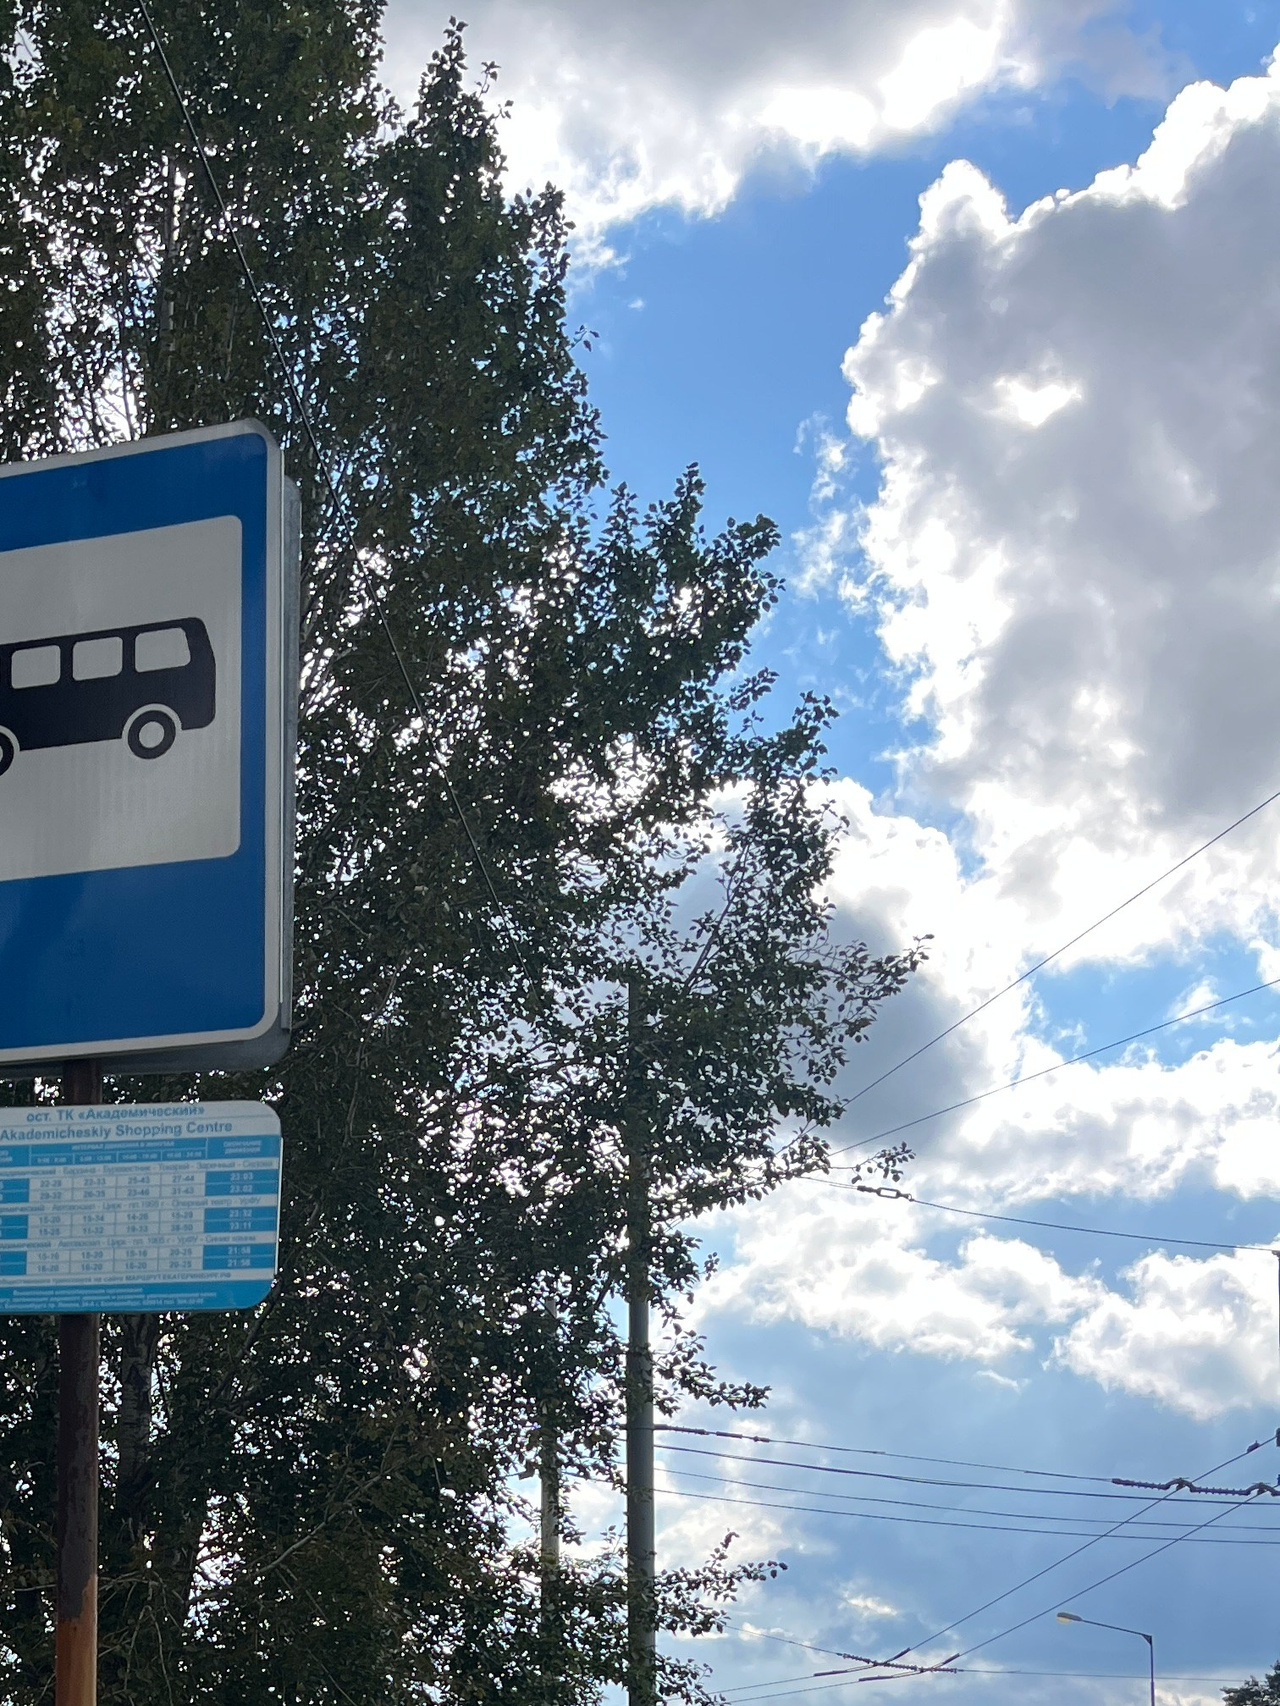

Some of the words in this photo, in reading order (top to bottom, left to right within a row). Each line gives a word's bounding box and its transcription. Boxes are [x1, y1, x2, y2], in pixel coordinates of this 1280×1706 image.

[26, 1112, 51, 1122] ост.
[56, 1109, 74, 1120] ТК
[78, 1105, 205, 1120] «Академический»
[0, 1125, 111, 1140] Akademicheskiy
[115, 1122, 182, 1137] Shopping
[185, 1121, 233, 1133] Centre
